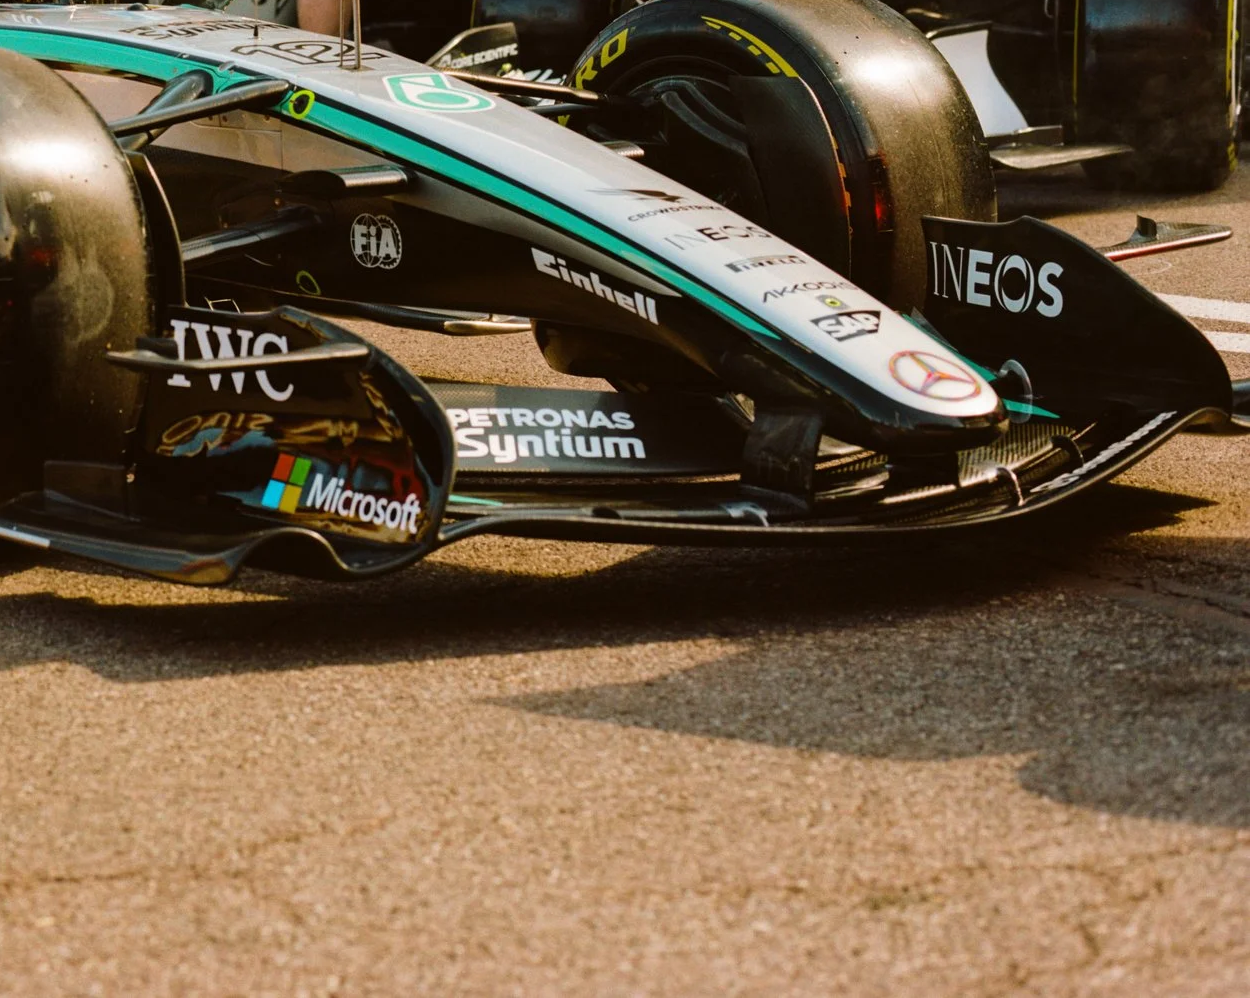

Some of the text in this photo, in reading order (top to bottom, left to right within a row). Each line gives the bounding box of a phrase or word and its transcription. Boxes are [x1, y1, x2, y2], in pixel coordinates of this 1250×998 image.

[230, 40, 392, 65] 12
[474, 43, 518, 65] SCIENTIFIC
[627, 204, 727, 222] CROWDSTRIKE
[664, 225, 772, 250] INEOS
[724, 254, 806, 273] PIRELLI
[531, 247, 659, 325] Einhell
[929, 241, 1064, 317] INEOS
[816, 313, 879, 339] SAP
[167, 319, 294, 401] IWC
[446, 408, 635, 429] PETRONAS
[456, 428, 647, 463] Syntium
[306, 472, 422, 535] Microsoft
